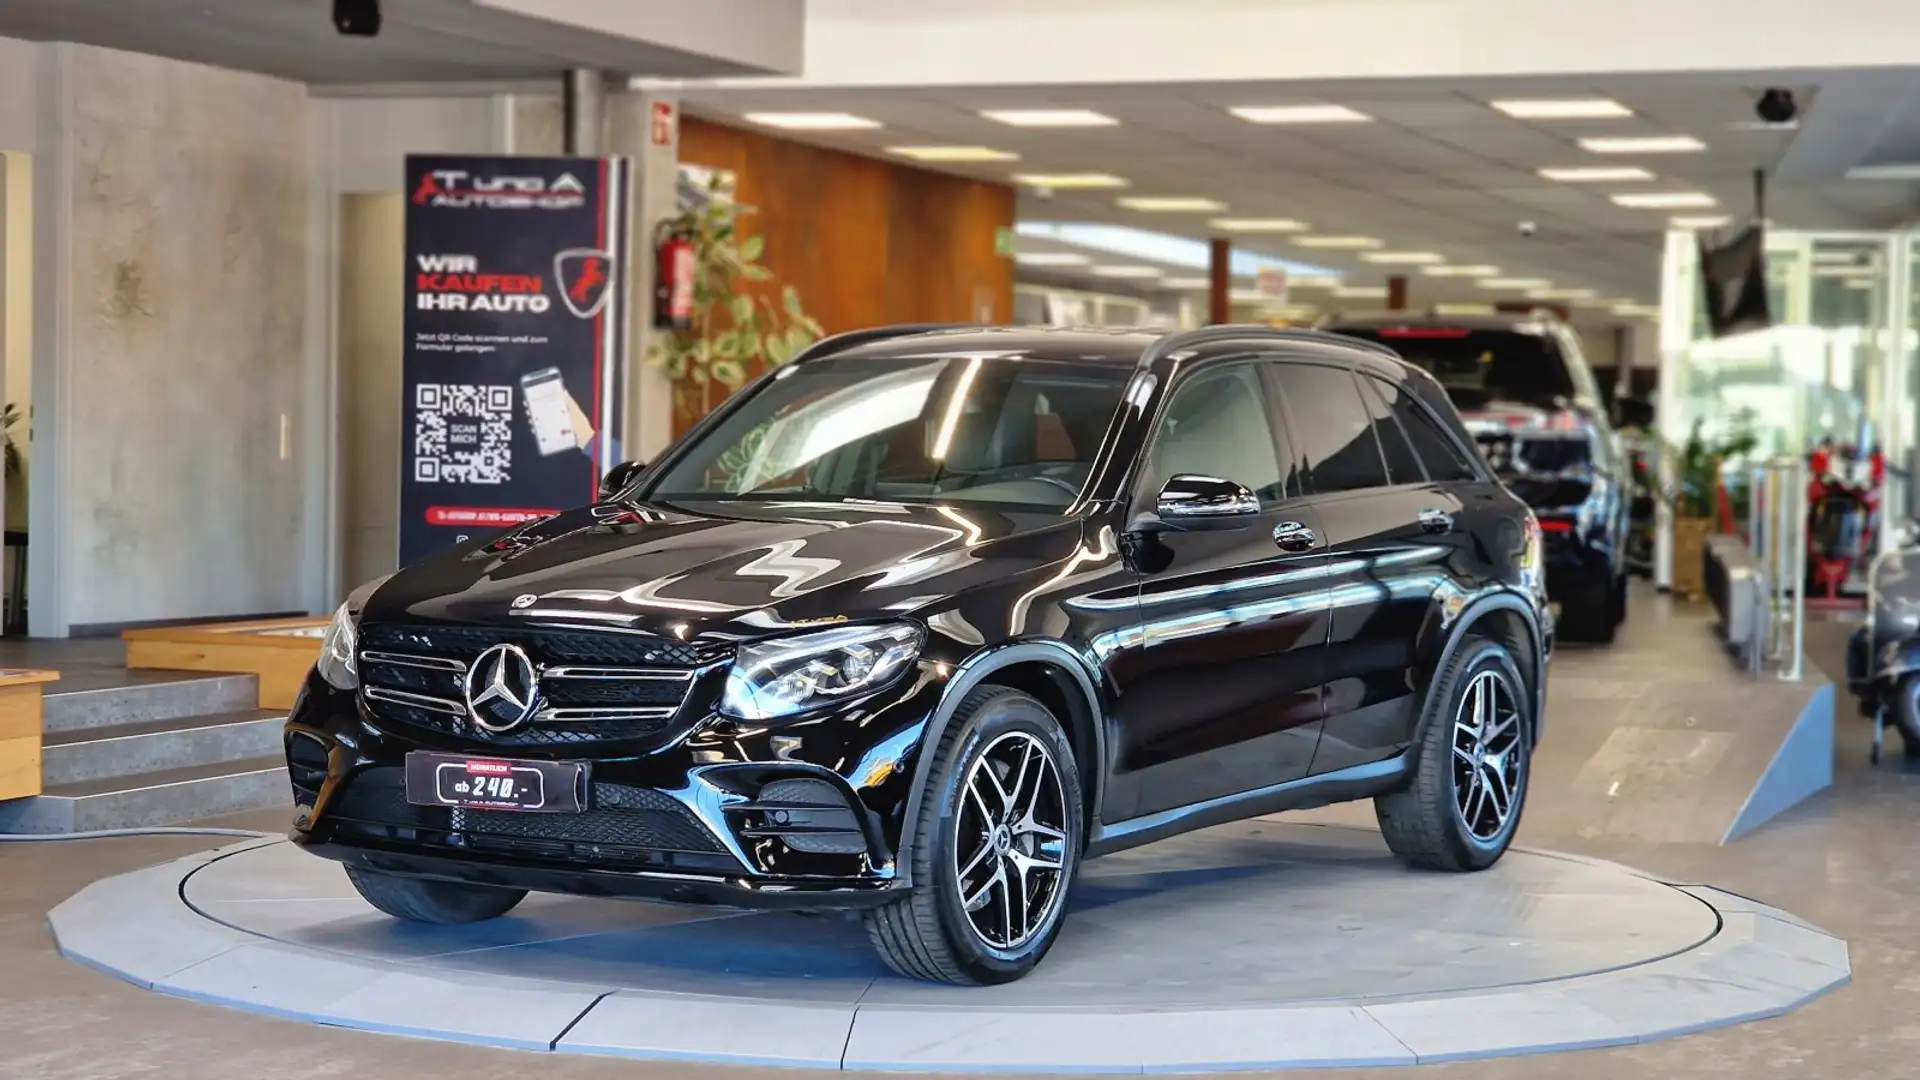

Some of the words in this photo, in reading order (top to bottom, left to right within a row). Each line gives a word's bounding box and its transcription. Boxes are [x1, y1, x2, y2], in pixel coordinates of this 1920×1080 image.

[417, 255, 478, 273] WIR
[416, 275, 542, 293] KAUFEN
[416, 293, 467, 310] IHR
[470, 294, 550, 313] AUTO
[451, 424, 477, 434] SCAN
[451, 434, 477, 444] MICH
[454, 780, 470, 793] ab
